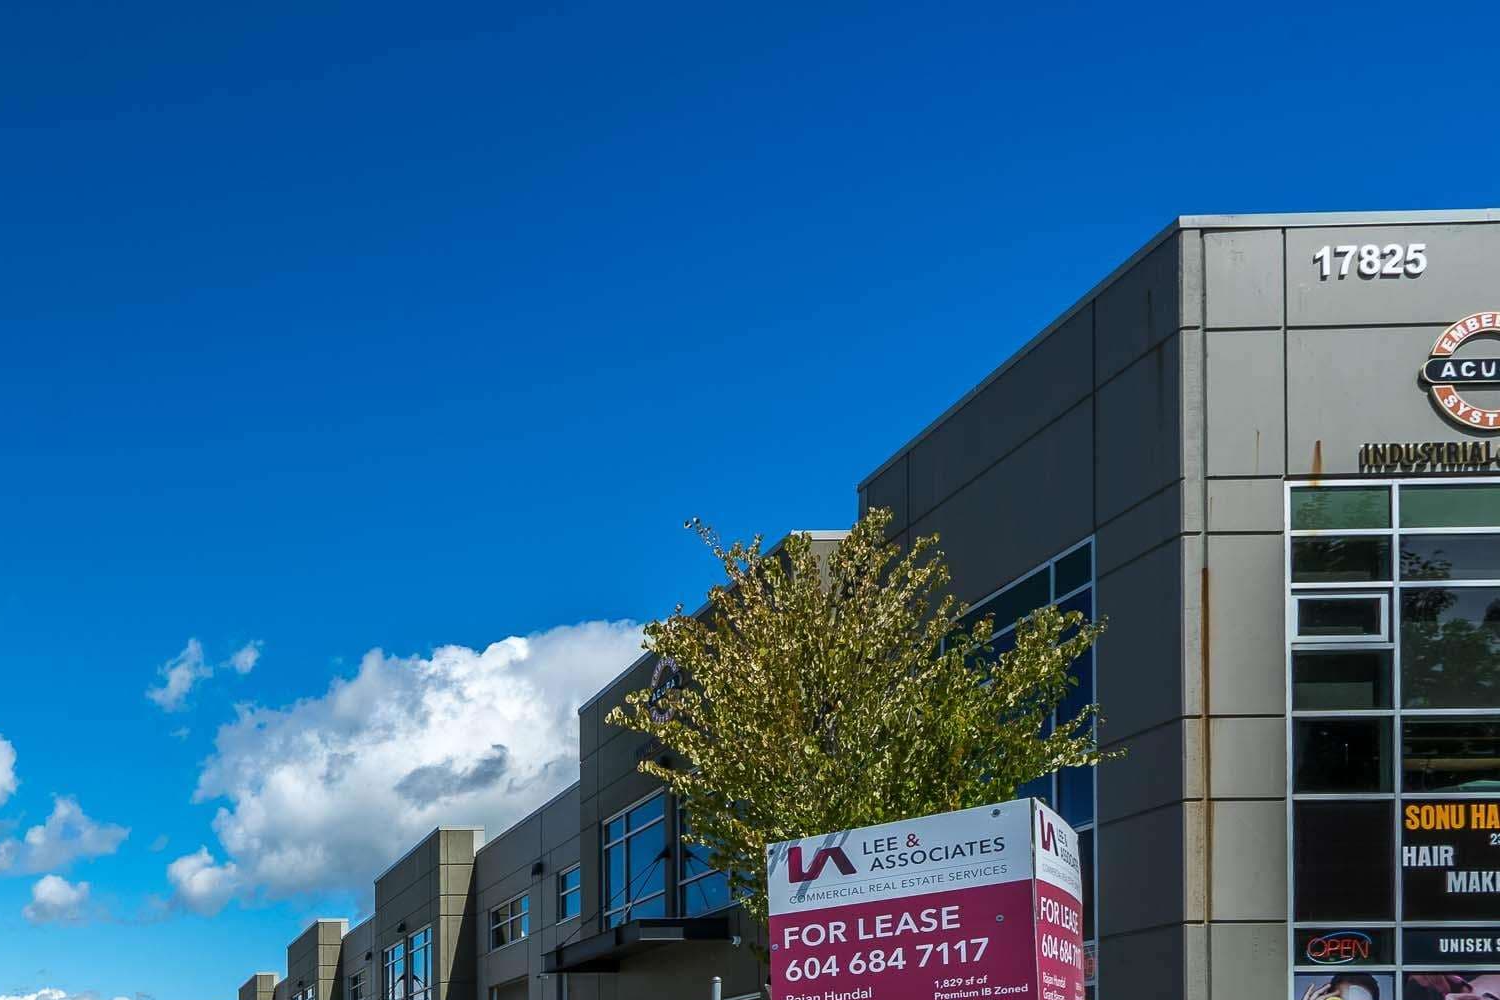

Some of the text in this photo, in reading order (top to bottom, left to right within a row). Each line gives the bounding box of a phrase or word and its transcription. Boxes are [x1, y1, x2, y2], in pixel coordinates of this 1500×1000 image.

[1314, 243, 1427, 276] 17825
[1362, 441, 1490, 465] INDUSTRIAL
[1405, 804, 1464, 829] SONU
[863, 833, 920, 855] LEE &
[870, 837, 1005, 871] ASSOCIATES
[1402, 846, 1454, 866] HAIR
[789, 864, 1008, 904] COMMERCIAL REAL ESTATE SERVICES
[784, 906, 960, 948] FOR LEASE
[1041, 896, 1078, 935] FOR LEASE
[1042, 933, 1058, 960] 604
[1060, 939, 1072, 964] 684
[1308, 939, 1368, 958] OPEN
[1439, 938, 1492, 952] UNISEX
[786, 937, 988, 982] 604 684 7117
[934, 975, 988, 988] 1,829 sf of
[935, 984, 1028, 1000] Premium IB Zoned
